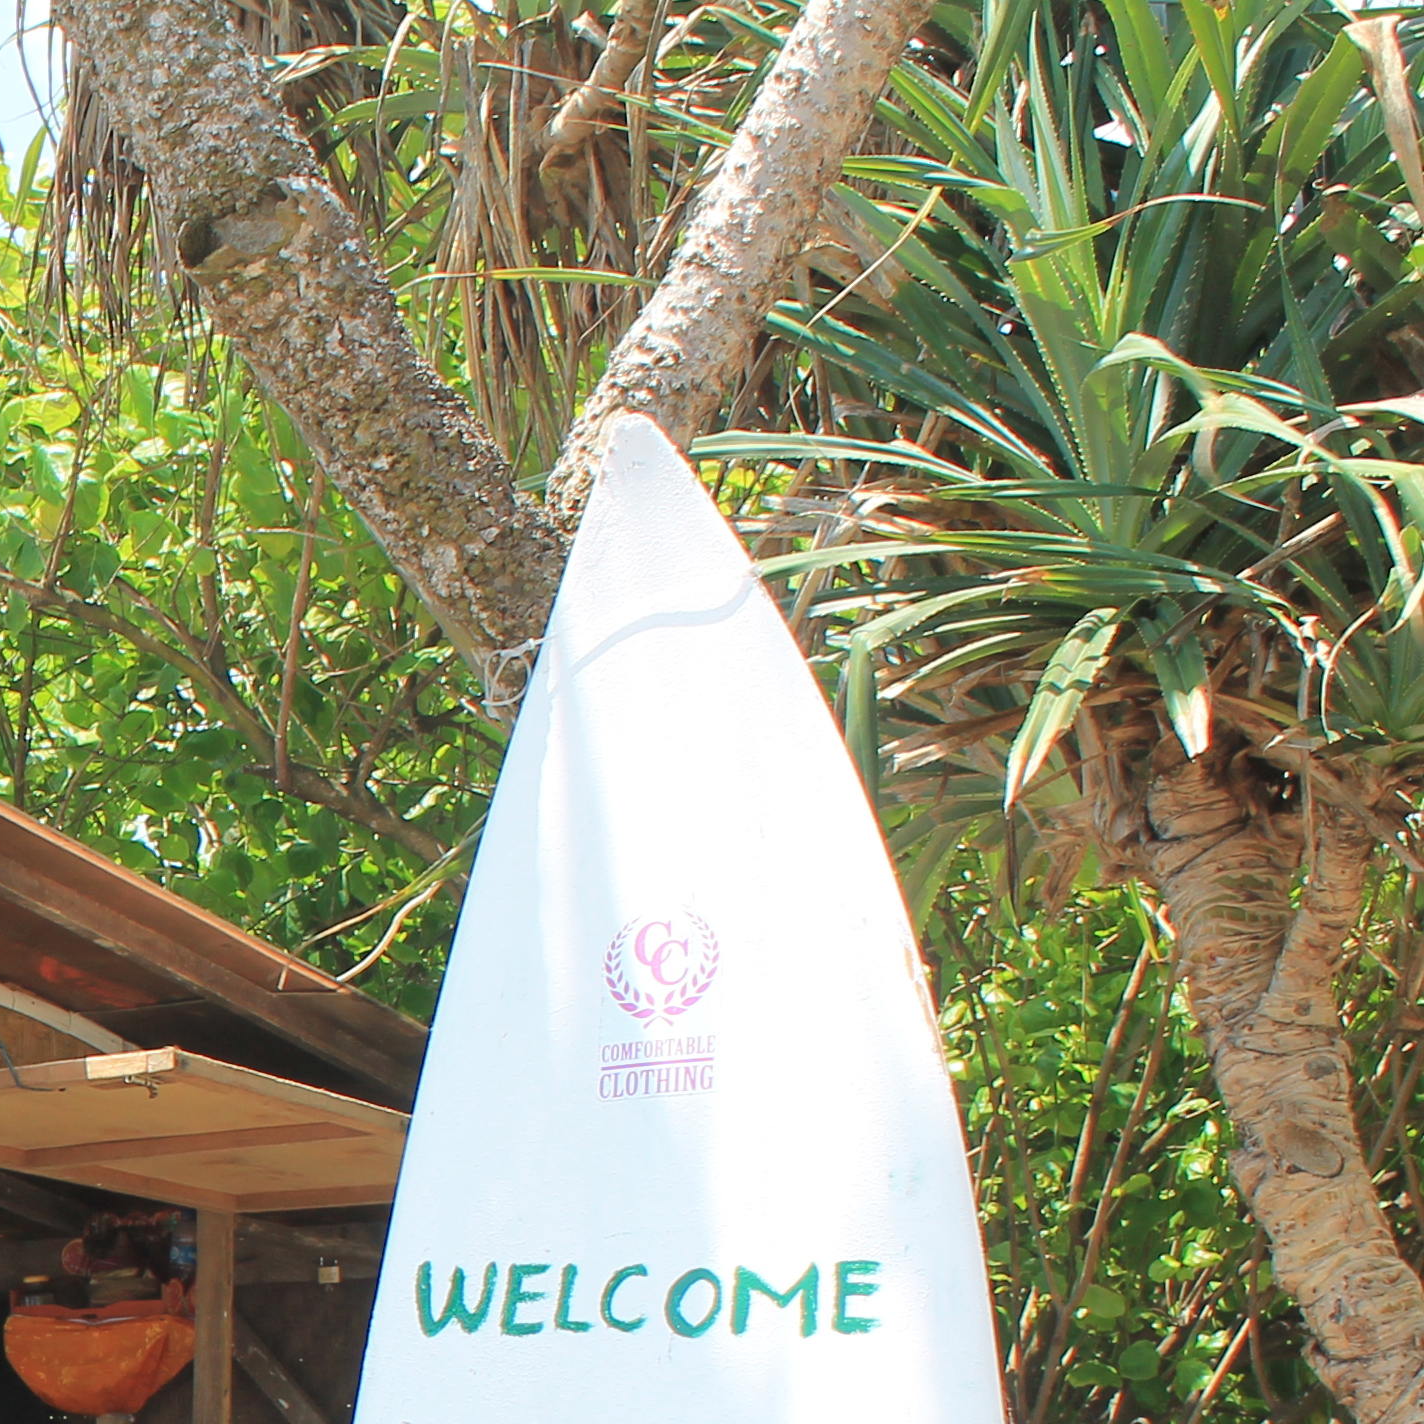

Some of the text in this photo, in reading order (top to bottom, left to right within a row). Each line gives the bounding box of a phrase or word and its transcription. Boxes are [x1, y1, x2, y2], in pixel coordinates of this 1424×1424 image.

[601, 1034, 717, 1063] COMFORTABLE
[598, 1064, 715, 1100] CLOTHING
[413, 1258, 884, 1340] WELCOME
